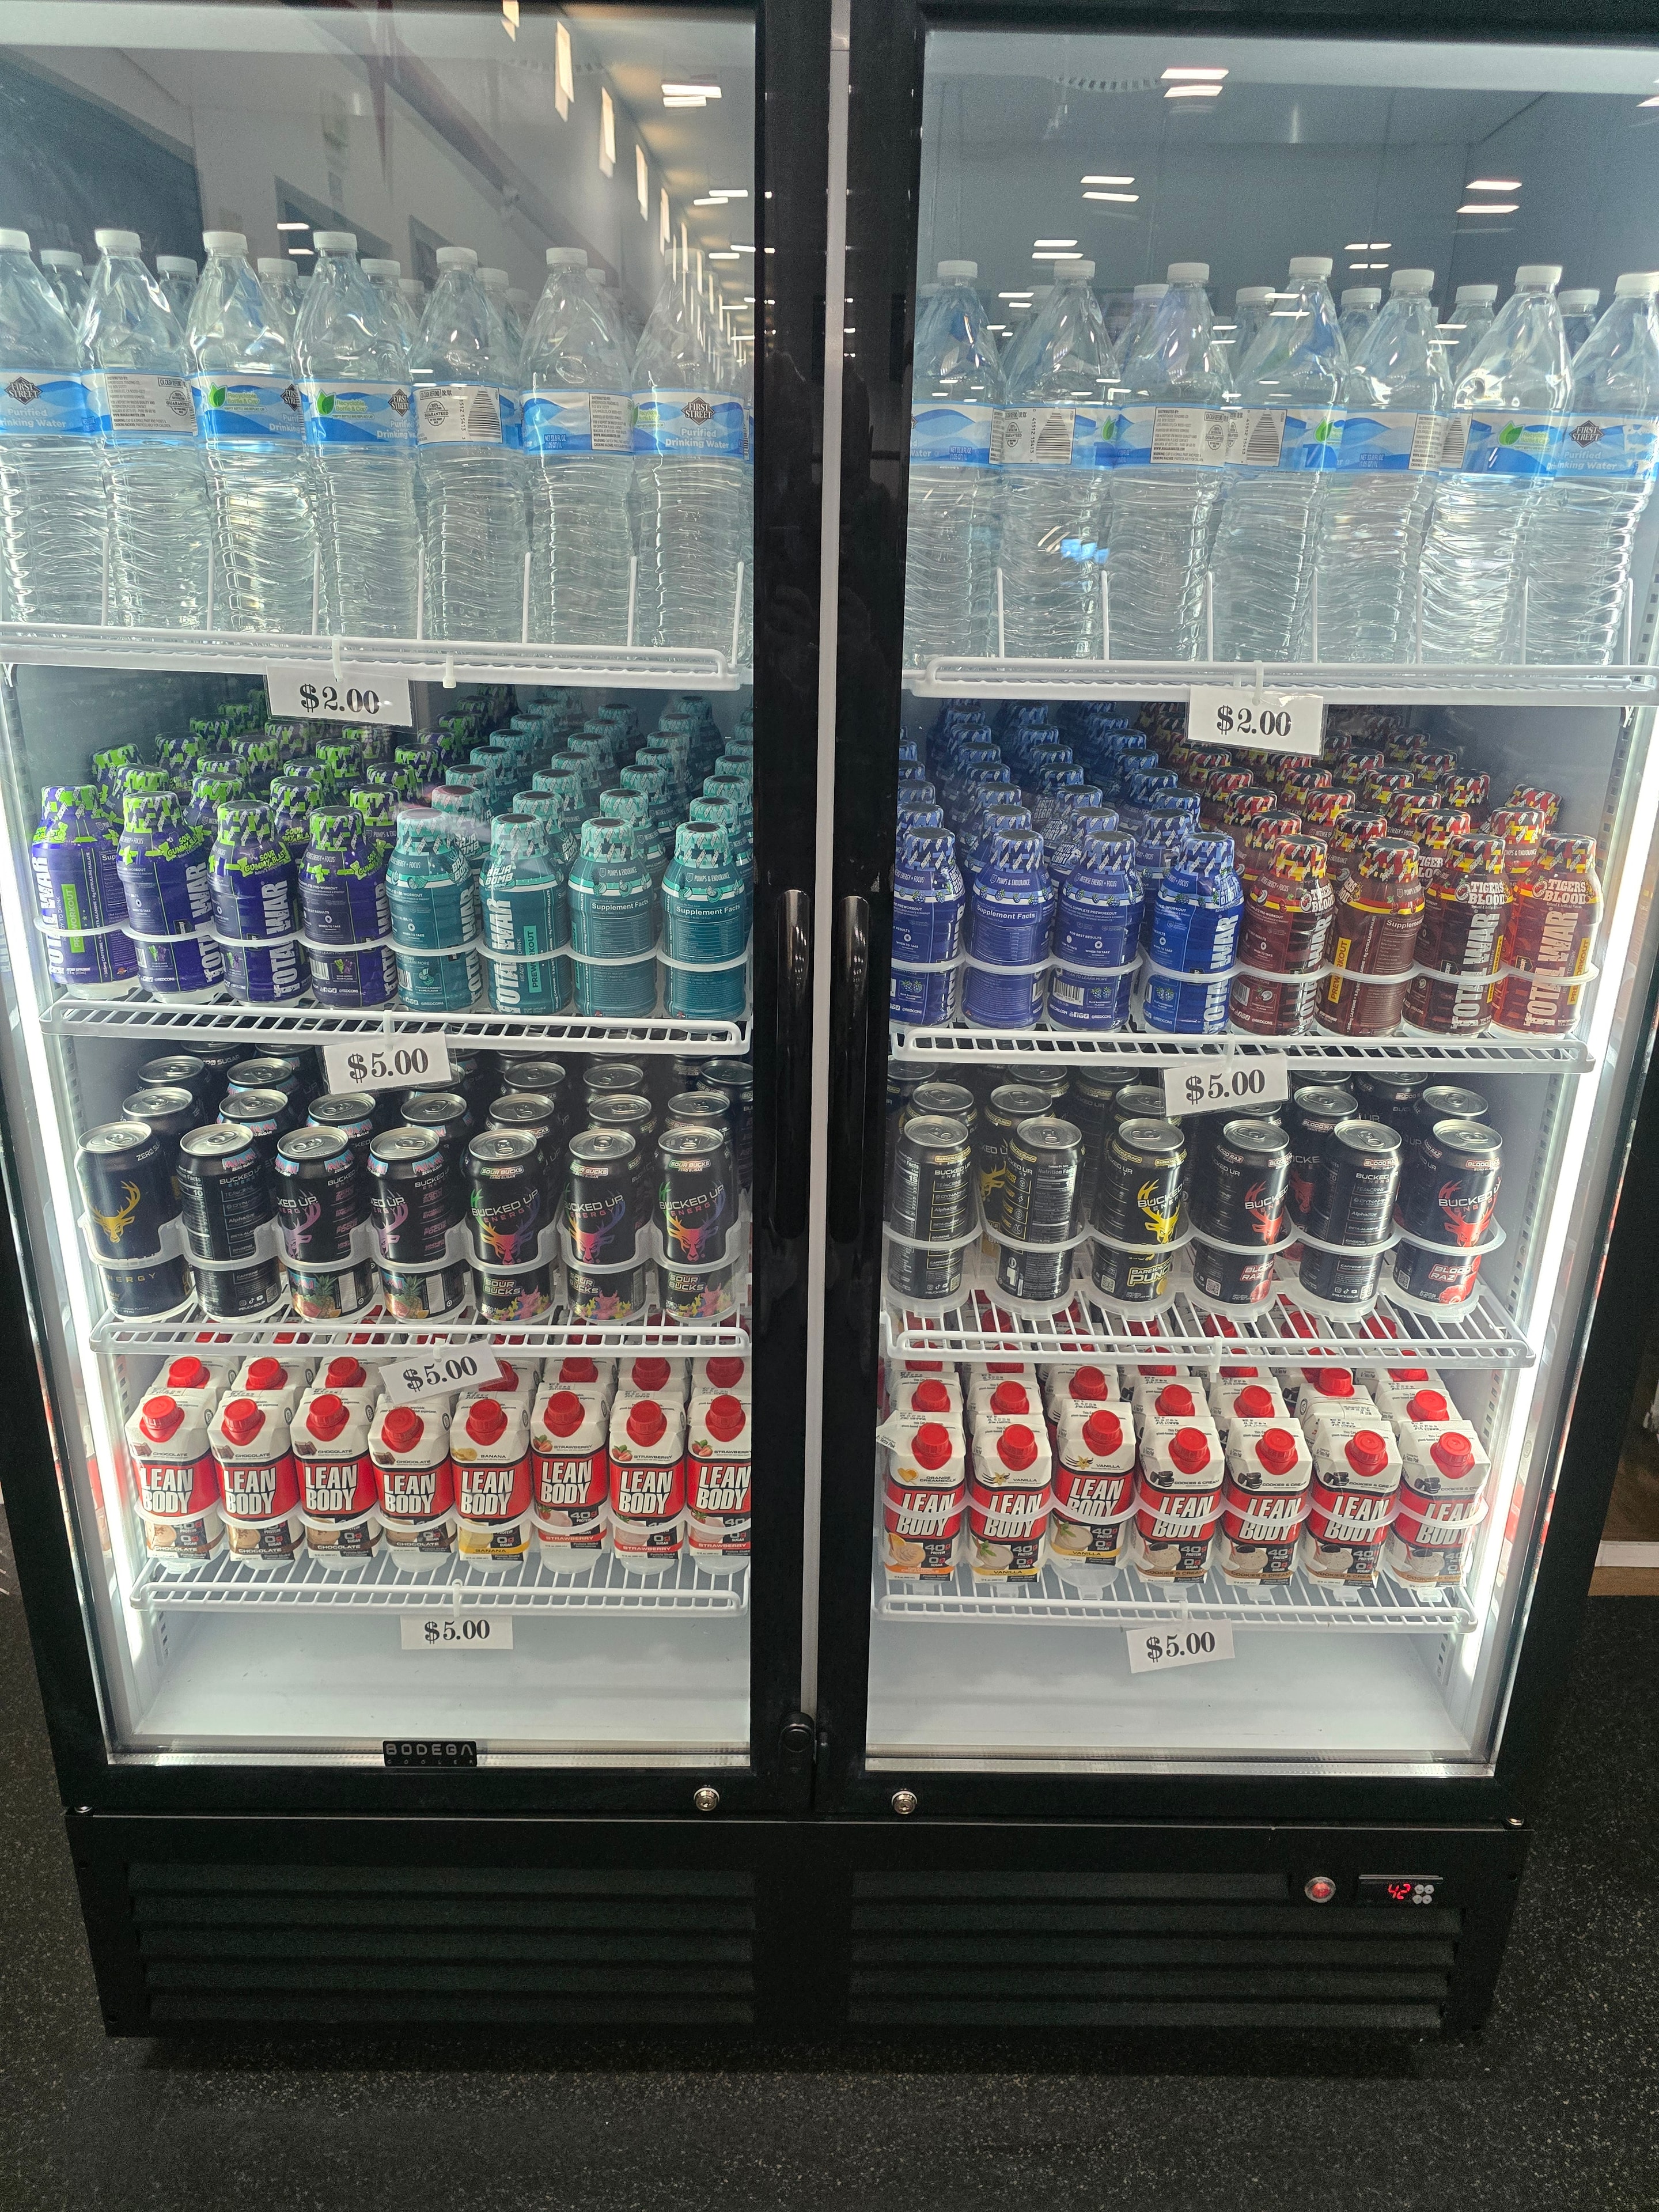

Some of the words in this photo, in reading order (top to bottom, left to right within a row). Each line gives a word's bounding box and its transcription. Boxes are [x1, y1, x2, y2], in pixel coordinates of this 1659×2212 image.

[12, 382, 34, 391] FIRST
[8, 408, 48, 416] Purified
[685, 411, 712, 419] STREET
[688, 403, 709, 411] FIRST
[681, 428, 716, 437] Purified
[665, 438, 704, 448] Drinking
[706, 440, 729, 449] Water
[300, 683, 380, 714] $2.00
[1217, 705, 1291, 736] $2.00
[260, 850, 275, 861] SOUR
[484, 874, 514, 885] BOMB
[486, 865, 512, 876] BAJA
[623, 866, 637, 875] ENDURANCE
[711, 872, 730, 881] ENDURANCE
[32, 857, 55, 908] WAR
[996, 878, 1007, 886] PUMPS
[1012, 878, 1031, 887] ENDURANCE
[1470, 881, 1504, 893] TIGERS
[1547, 879, 1586, 893] TIGERS
[262, 880, 291, 935] WAR
[592, 903, 634, 911] Supplement
[635, 900, 649, 908] Facts
[1312, 895, 1335, 912] BLOOD
[1468, 894, 1505, 906] BLOOD
[1544, 892, 1587, 904] BLOOD
[676, 906, 722, 915] Supplement
[724, 904, 741, 913] Facts
[977, 904, 1016, 919] Supplement
[487, 898, 515, 950] WAR
[1210, 914, 1239, 969] WAR
[1463, 914, 1500, 964] WAR
[1537, 911, 1578, 961] WAR
[347, 1048, 429, 1084] $5.00
[1185, 1069, 1265, 1105] $5.00
[219, 1171, 253, 1184] BUCKED
[328, 1170, 355, 1186] BUCKED
[500, 1166, 522, 1175] BUCKS
[571, 1162, 585, 1173] SOUR
[585, 1167, 608, 1175] BUCKS
[934, 1166, 964, 1175] BUCKED
[415, 1173, 444, 1188] BUCKED
[471, 1200, 521, 1217] BUCKED
[522, 1189, 539, 1205] UP
[660, 1195, 707, 1210] BUCKED
[1137, 1183, 1184, 1209] BUCKED
[1245, 1184, 1289, 1210] BUCKED
[1438, 1190, 1491, 1207] BUCKED
[483, 1203, 532, 1224] ENERGY
[671, 1199, 718, 1217] ENERGY
[1245, 1261, 1274, 1273] BLOOD
[1431, 1272, 1457, 1281] RAZ
[484, 1279, 516, 1288] SOUR
[570, 1281, 600, 1294] BUCKS
[668, 1281, 704, 1291] BUCKS
[669, 1274, 699, 1283] SOUR
[484, 1287, 521, 1296] BUCKS
[403, 1357, 478, 1392] $5.00
[141, 1468, 194, 1491] LEAN
[224, 1467, 276, 1493] LEAN
[305, 1464, 358, 1488] LEAN
[541, 1459, 592, 1484] LEAN
[699, 1465, 751, 1489] LEAN
[384, 1472, 435, 1494] LEAN
[462, 1469, 514, 1494] LEAN
[621, 1470, 673, 1493] LEAN
[1070, 1478, 1124, 1500] LEAN
[144, 1491, 191, 1514] BODY
[225, 1491, 274, 1514] BODY
[306, 1488, 357, 1512] BODY
[540, 1482, 590, 1504] BODY
[696, 1488, 748, 1510] BODY
[385, 1493, 435, 1514] BODY
[461, 1492, 511, 1516] BODY
[619, 1492, 670, 1514] BODY
[902, 1493, 956, 1515] LEAN
[989, 1493, 1042, 1516] LEAN
[1067, 1498, 1118, 1517] BODY
[1158, 1496, 1214, 1518] LEAN
[1247, 1498, 1301, 1520] LEAN
[1332, 1496, 1391, 1521] LEAN
[896, 1516, 949, 1537] BODY
[984, 1518, 1035, 1538] BODY
[1152, 1523, 1207, 1538] BODY
[1239, 1524, 1294, 1541] BODY
[1324, 1524, 1380, 1543] BODY
[425, 1619, 490, 1645] $5.00
[1146, 1631, 1215, 1663] $5.00
[385, 1744, 473, 1755] BODEGA
